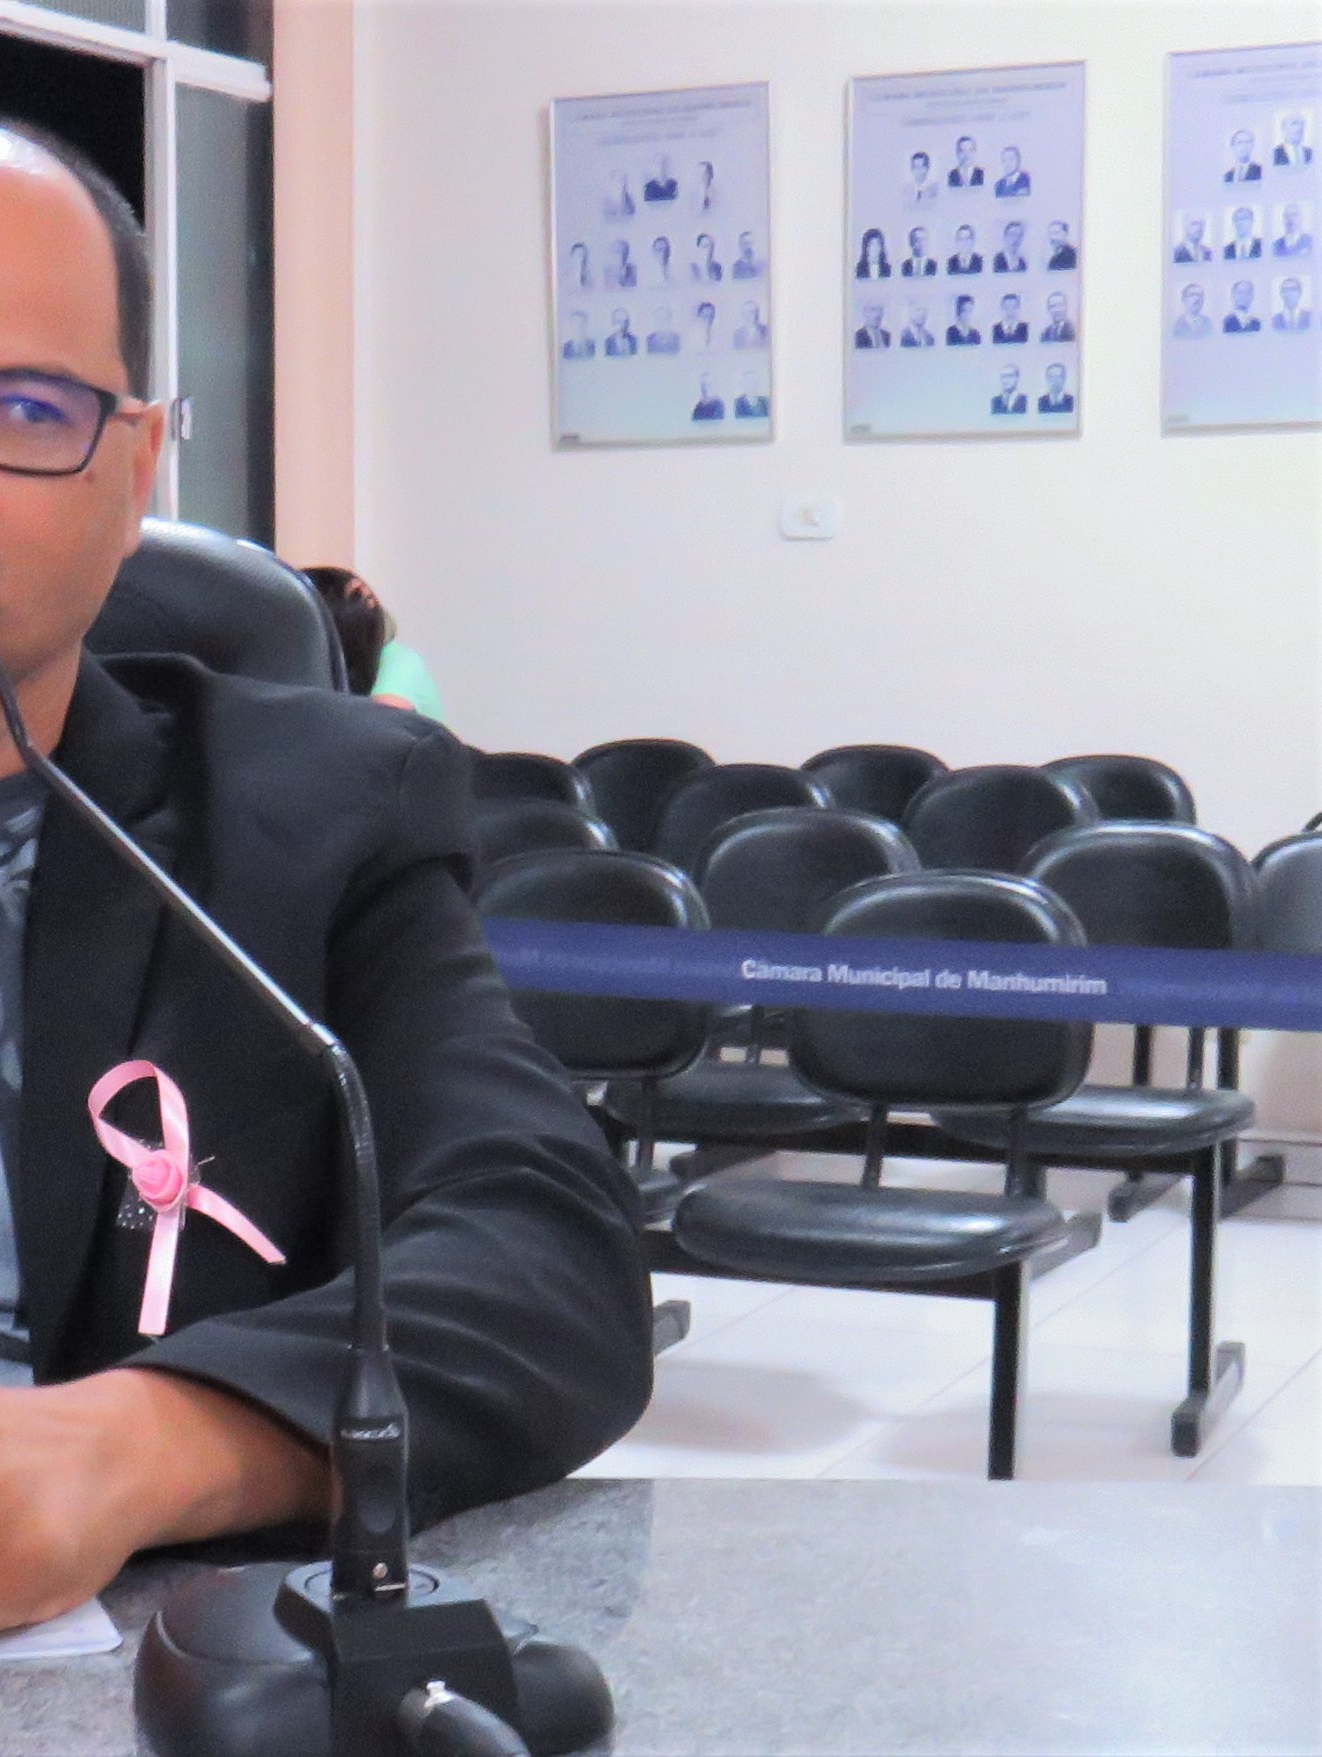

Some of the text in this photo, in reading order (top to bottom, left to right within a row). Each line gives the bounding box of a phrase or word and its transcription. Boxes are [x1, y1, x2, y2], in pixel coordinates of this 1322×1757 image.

[828, 963, 930, 990] Municipal
[934, 969, 962, 990] de
[967, 970, 1108, 995] Manhumirim
